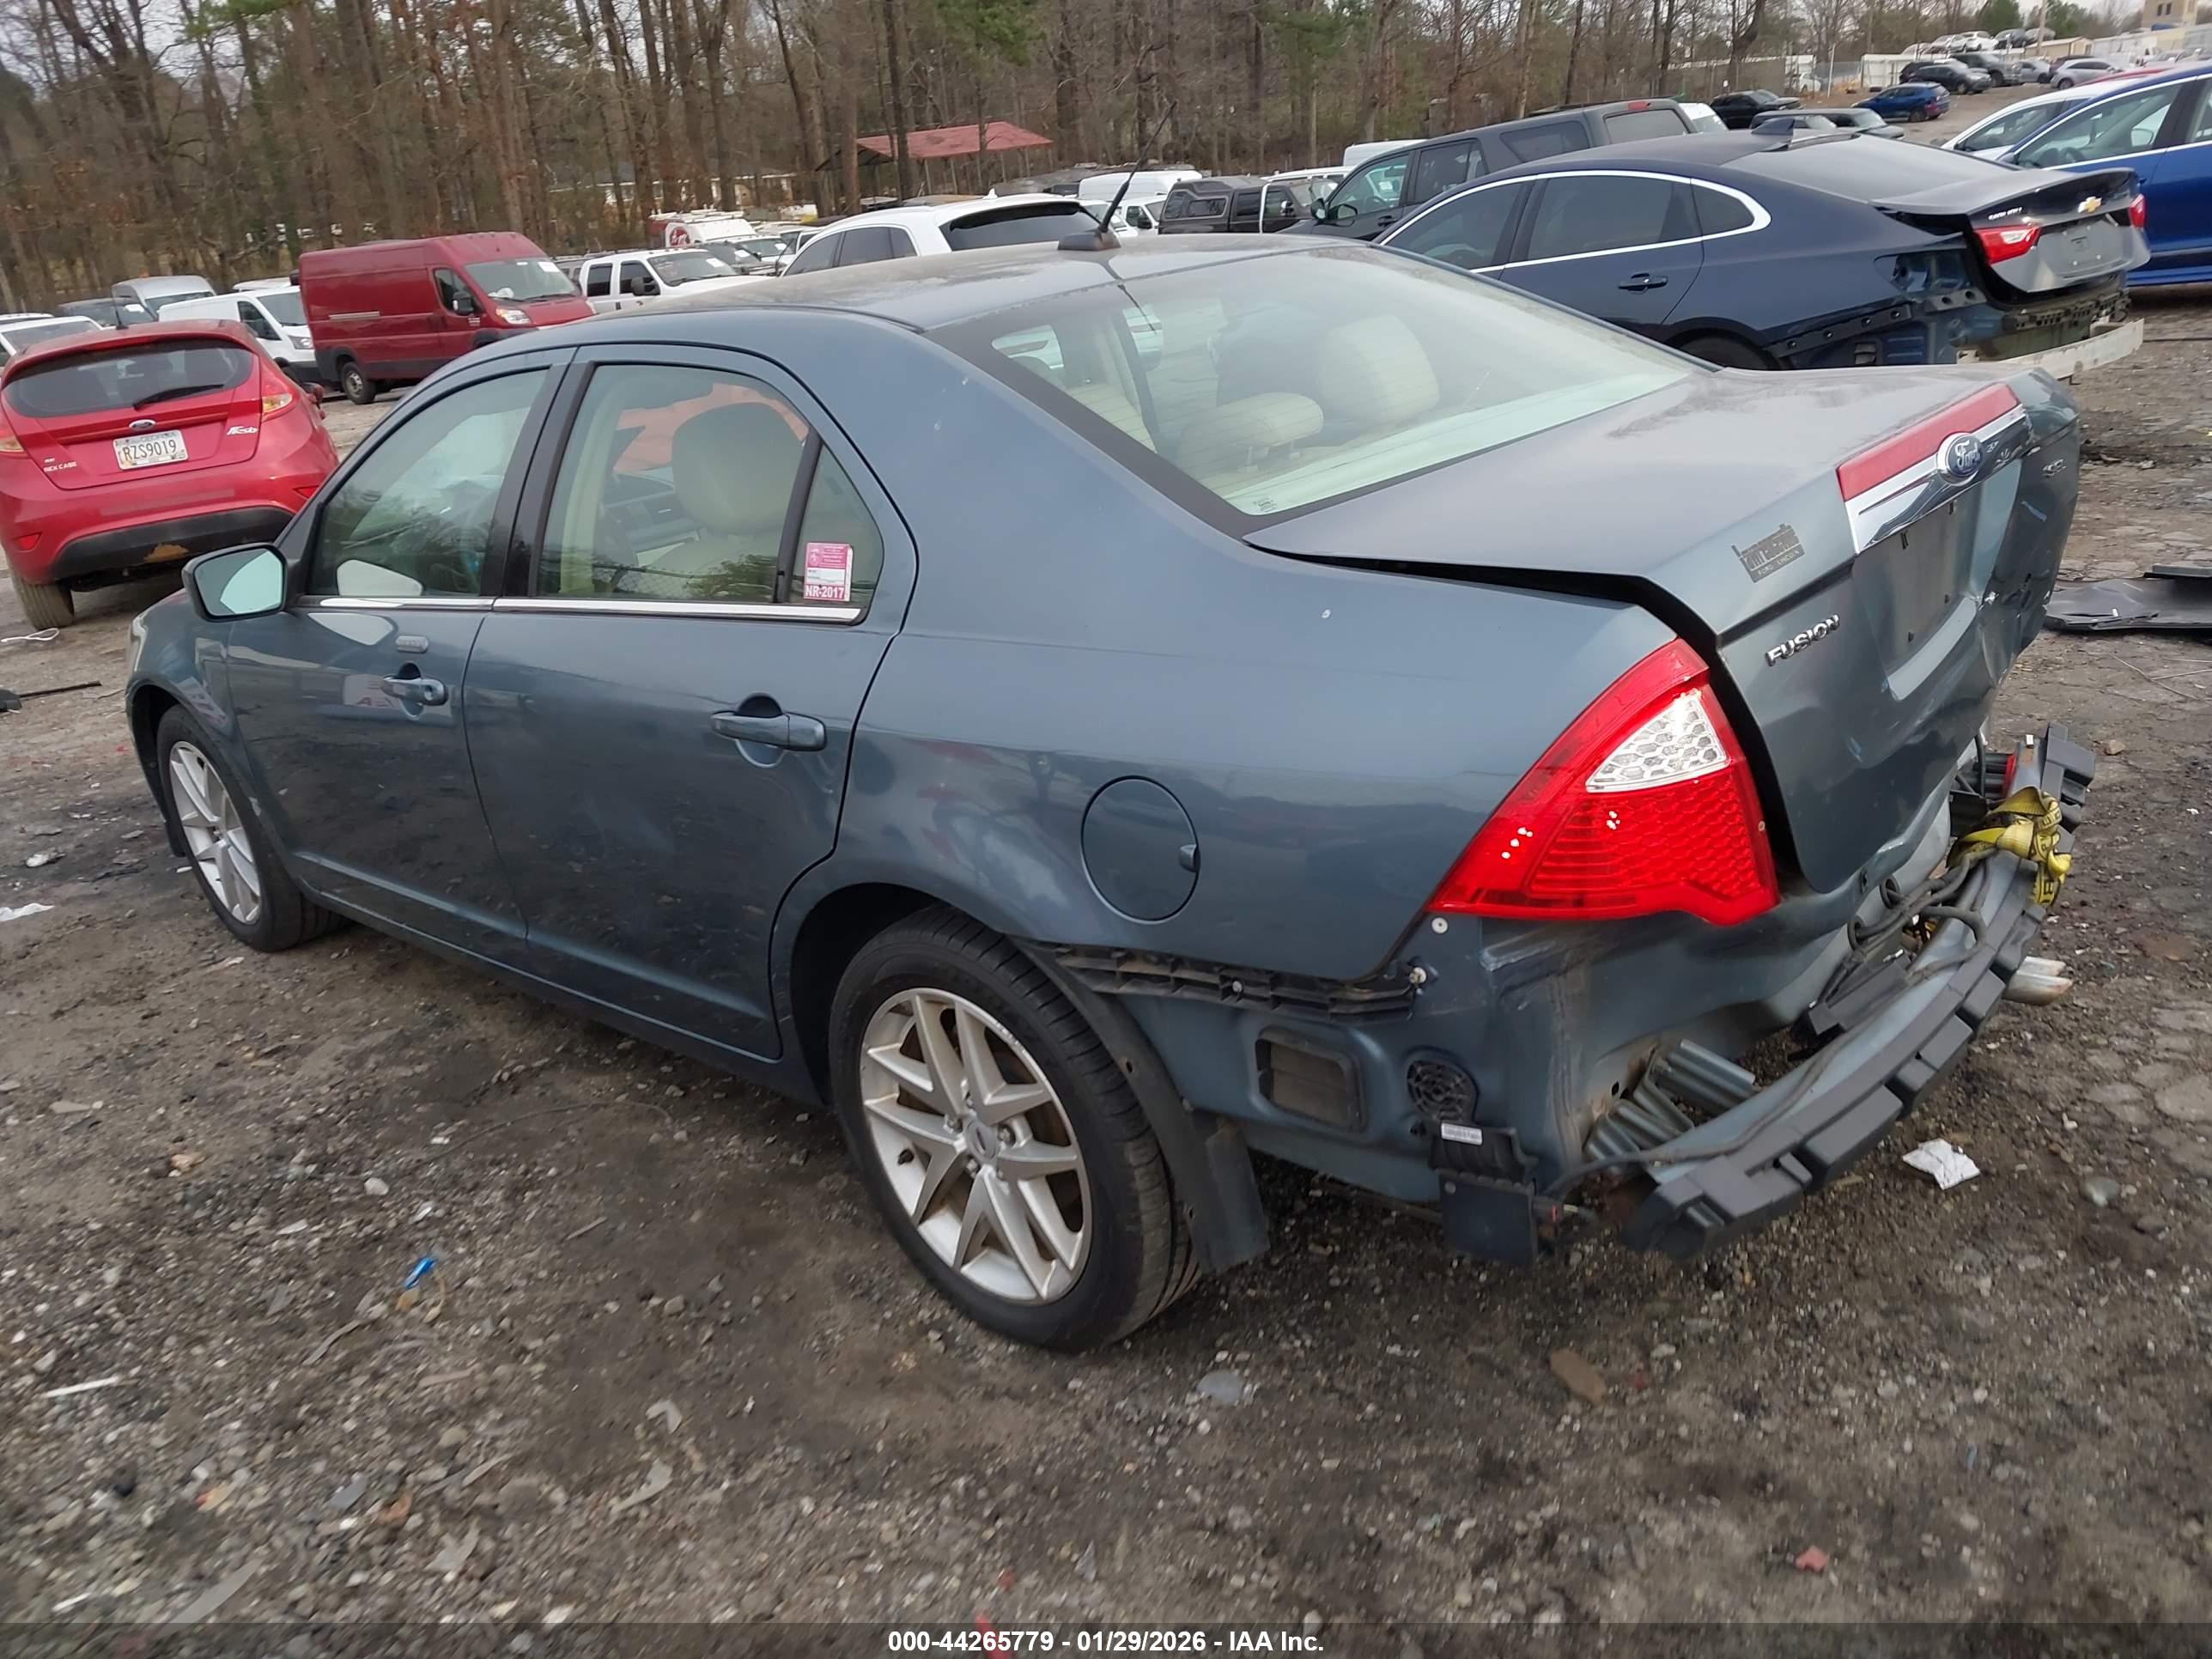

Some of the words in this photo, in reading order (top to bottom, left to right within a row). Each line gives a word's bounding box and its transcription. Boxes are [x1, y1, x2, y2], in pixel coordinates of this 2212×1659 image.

[122, 439, 177, 462] RZS9019
[1954, 440, 1982, 468] Ford
[1765, 614, 1839, 666] FUSION
